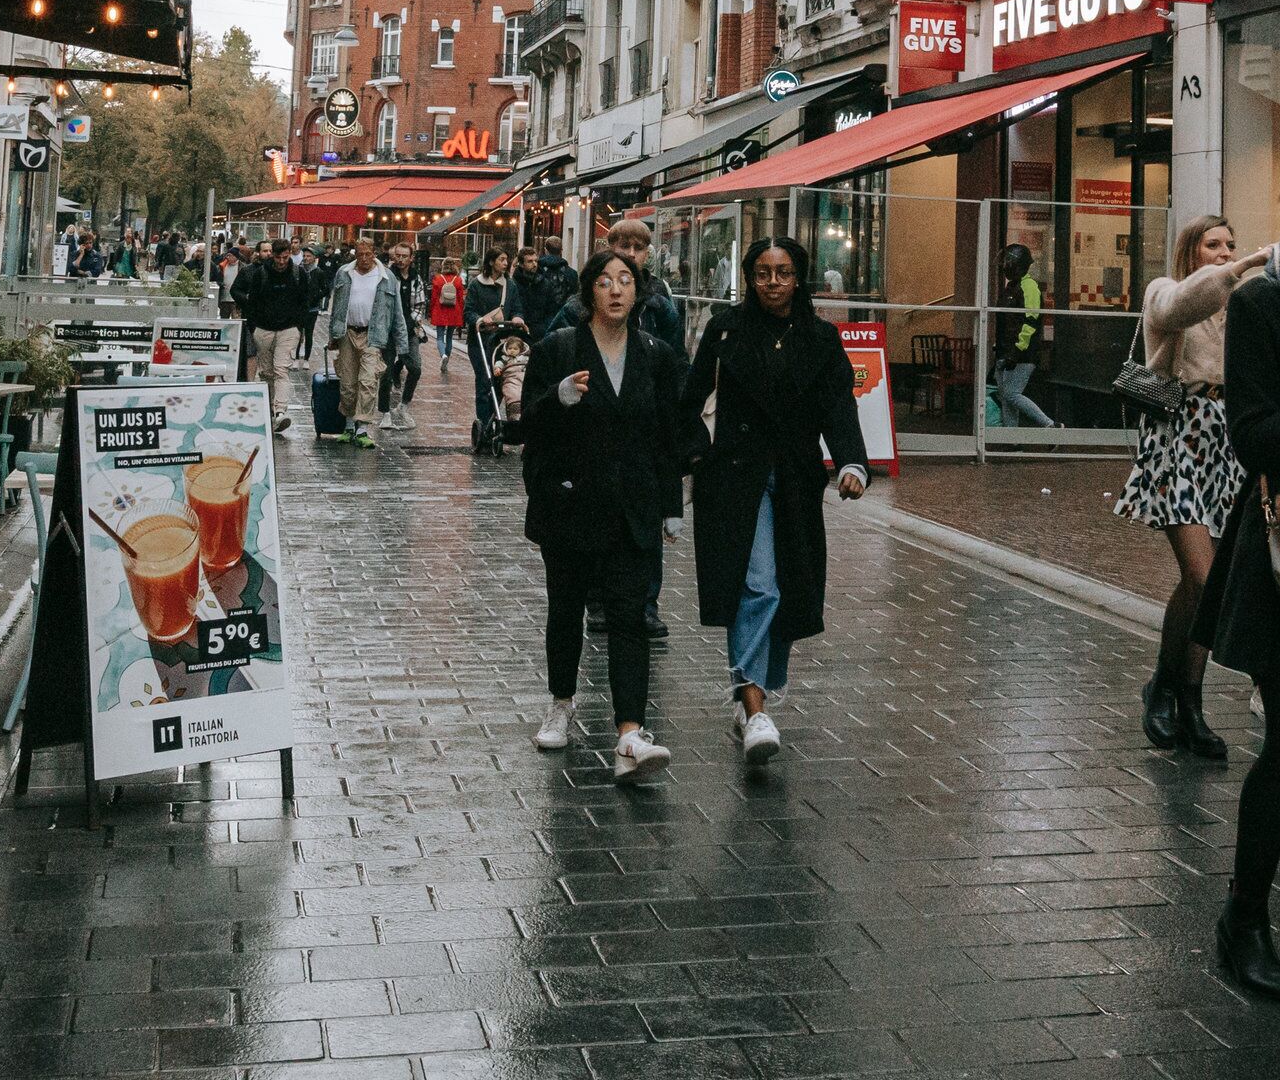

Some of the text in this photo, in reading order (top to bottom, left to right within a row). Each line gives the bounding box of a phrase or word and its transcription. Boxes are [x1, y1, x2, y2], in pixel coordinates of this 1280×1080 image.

[910, 17, 957, 36] FIVE
[903, 34, 963, 54] GUYS
[1180, 74, 1202, 102] A3
[442, 129, 490, 159] AU
[163, 329, 218, 339] UNE DOUCEUR ?
[841, 330, 878, 341] GUYS
[99, 411, 163, 428] UN JUS DE
[100, 431, 155, 447] FRUITS ?
[170, 455, 200, 463] VITAMINE
[188, 663, 207, 671] FRUITS
[160, 717, 224, 744] IT ITALIAN
[189, 730, 240, 749] TRATTORIA
